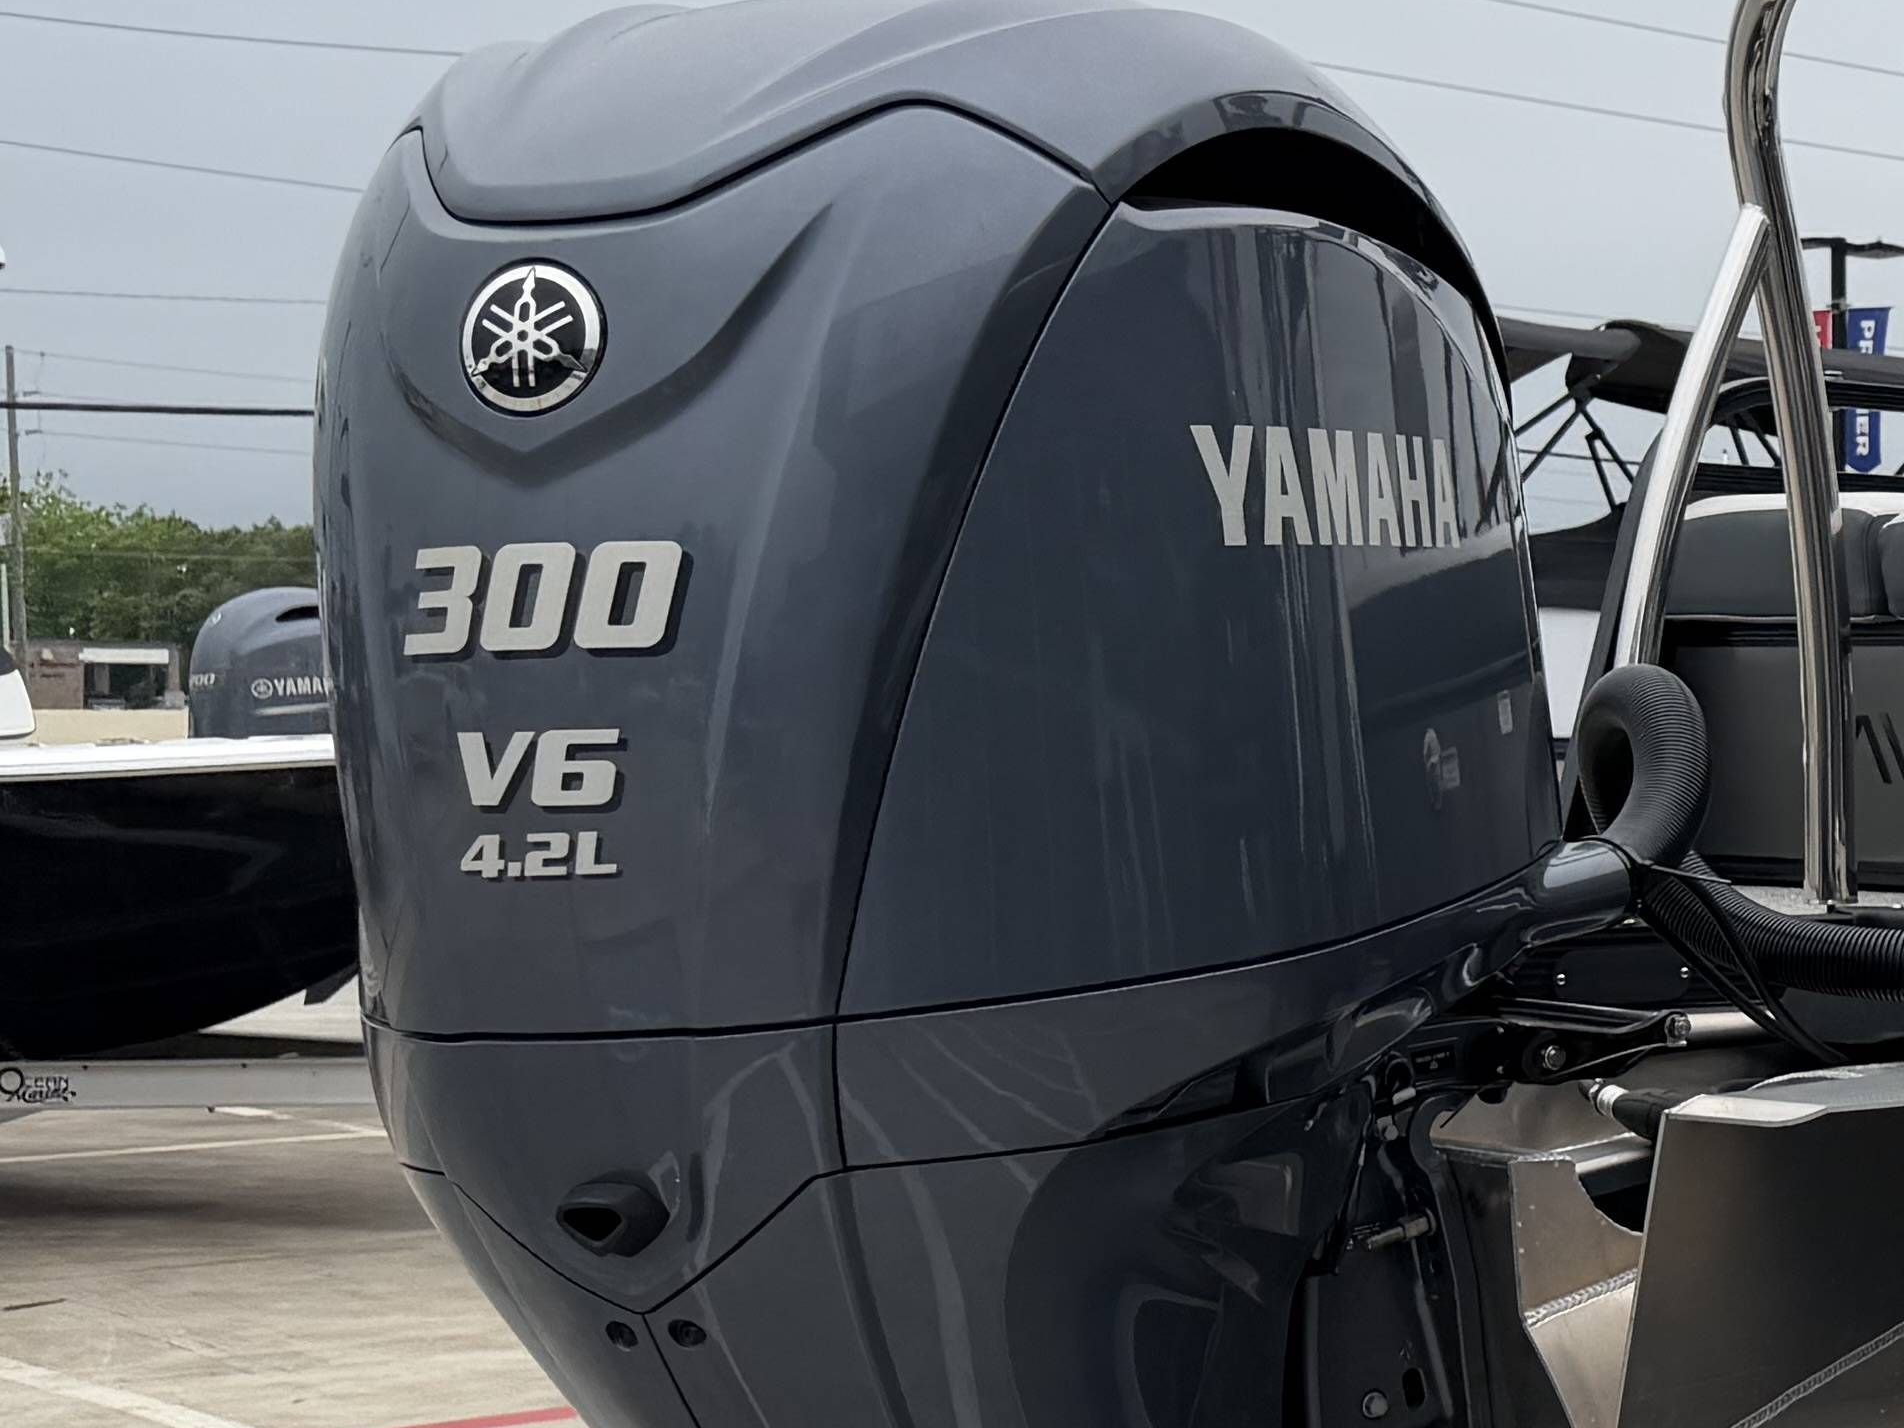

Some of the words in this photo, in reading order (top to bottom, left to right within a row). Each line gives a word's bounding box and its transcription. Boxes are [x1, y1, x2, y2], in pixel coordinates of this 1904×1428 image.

[1189, 424, 1460, 548] YAMAHA
[403, 540, 684, 656] 300
[456, 728, 620, 807] V6
[460, 831, 618, 879] 4.2L
